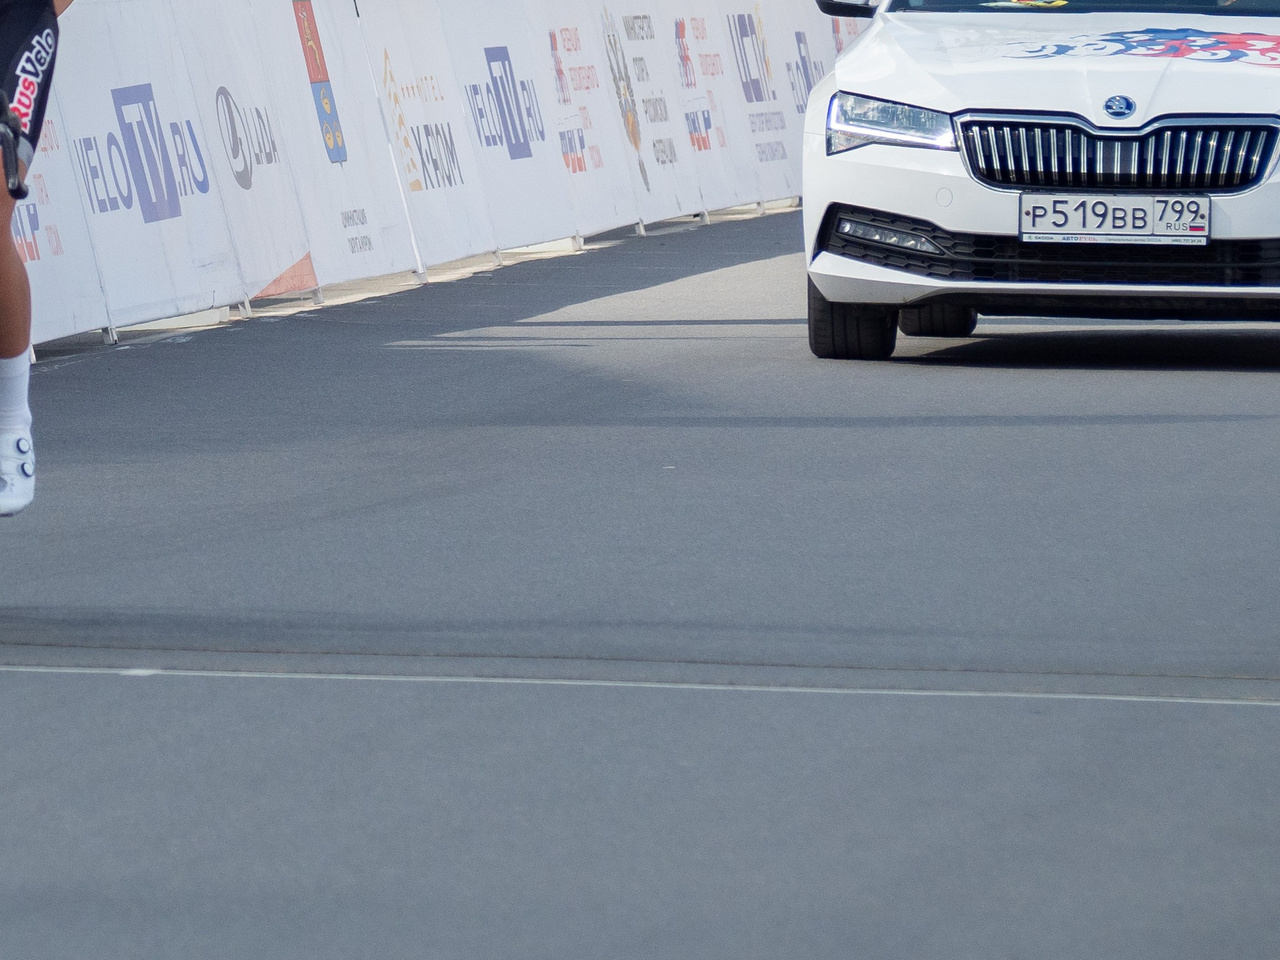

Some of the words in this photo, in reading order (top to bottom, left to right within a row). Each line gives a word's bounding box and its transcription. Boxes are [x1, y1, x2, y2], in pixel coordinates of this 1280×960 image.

[242, 107, 281, 165] LADA
[1155, 200, 1200, 222] 799
[1165, 222, 1188, 231] RUS
